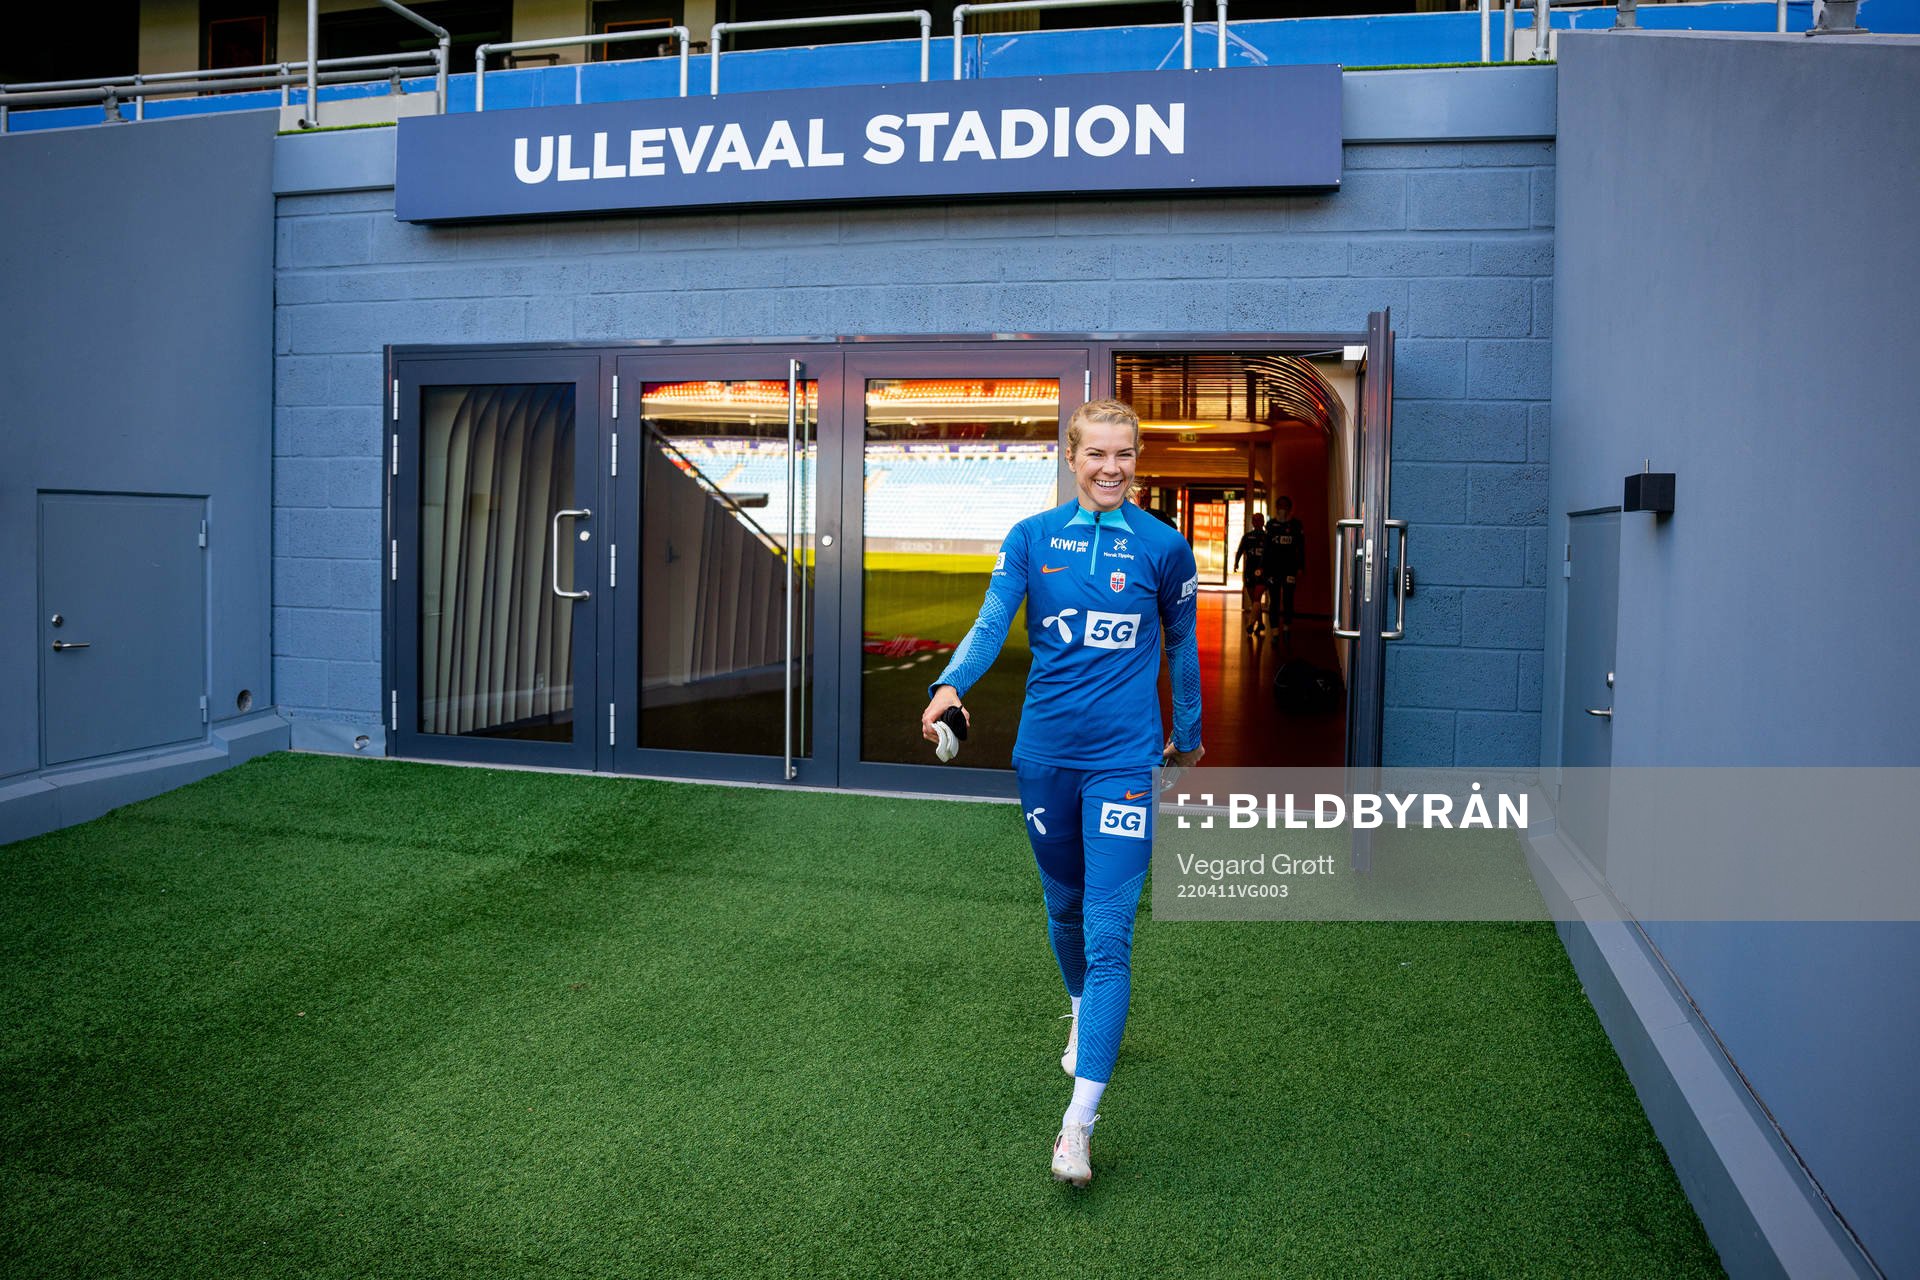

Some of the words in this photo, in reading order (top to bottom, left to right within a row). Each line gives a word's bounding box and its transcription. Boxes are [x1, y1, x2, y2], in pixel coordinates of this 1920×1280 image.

[514, 118, 845, 184] ULLEVAAL
[863, 102, 1185, 165] STADION
[1050, 536, 1077, 552] KIWI
[1091, 619, 1134, 643] 5G
[1104, 809, 1141, 832] 5G
